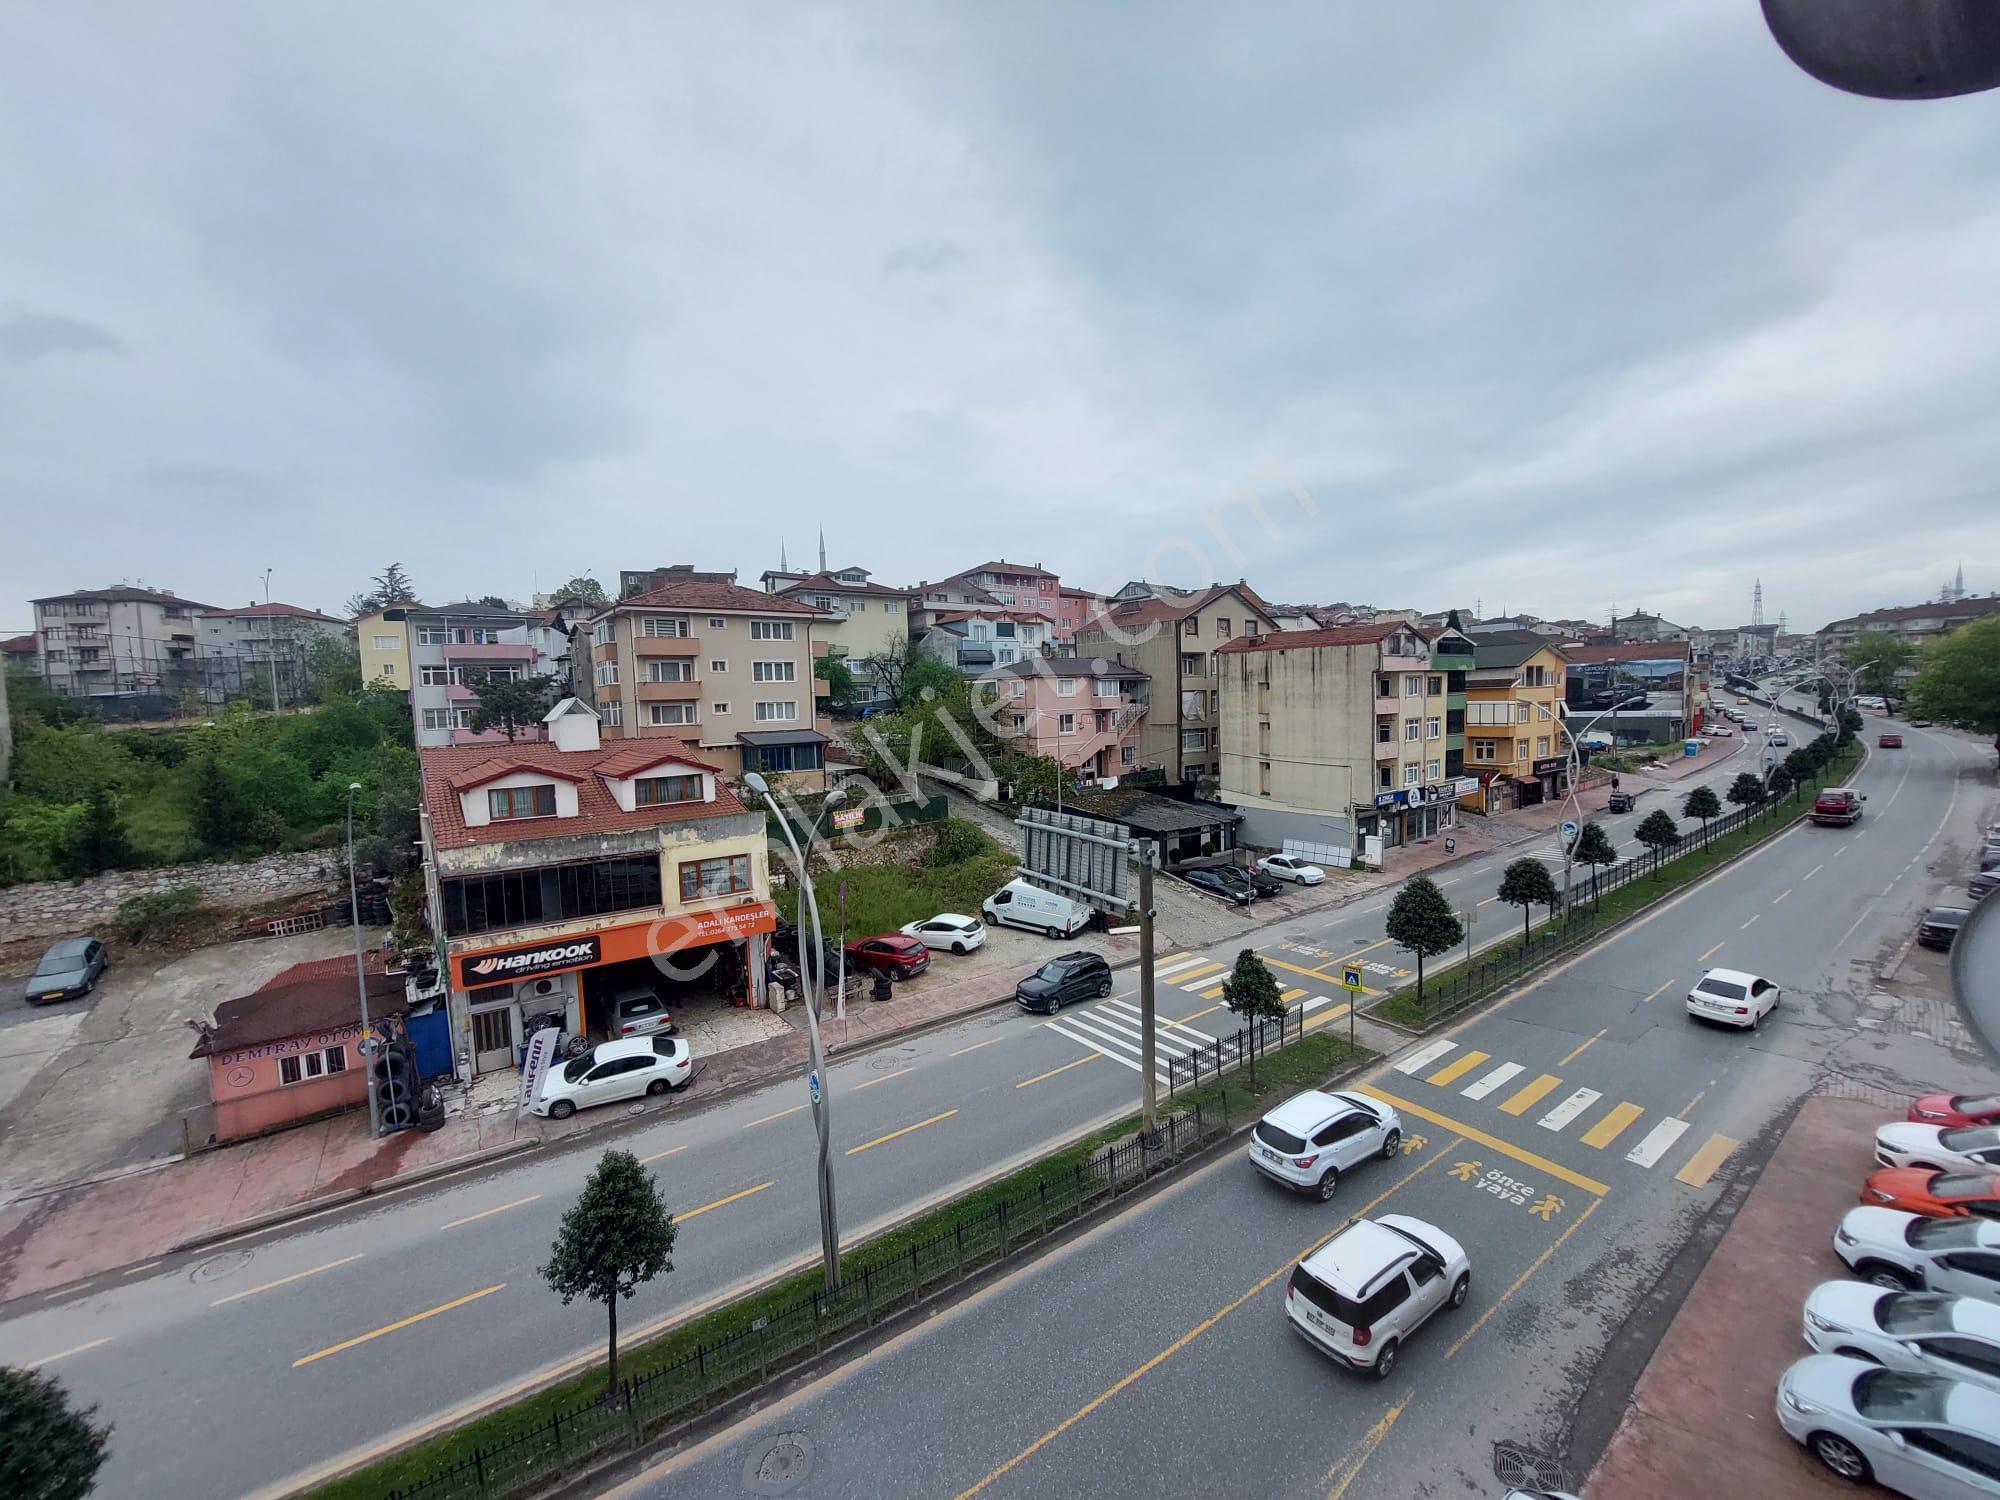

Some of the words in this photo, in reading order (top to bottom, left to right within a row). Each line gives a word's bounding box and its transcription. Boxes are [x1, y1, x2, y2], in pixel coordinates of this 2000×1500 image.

[697, 919, 722, 930] ADALI
[723, 910, 769, 925] KARDEŞLER
[515, 962, 551, 974] driving
[552, 954, 593, 967] emotion
[222, 1038, 312, 1066] DEMİRAY
[1474, 1177, 1525, 1206] yaya
[1486, 1168, 1535, 1197] önce
